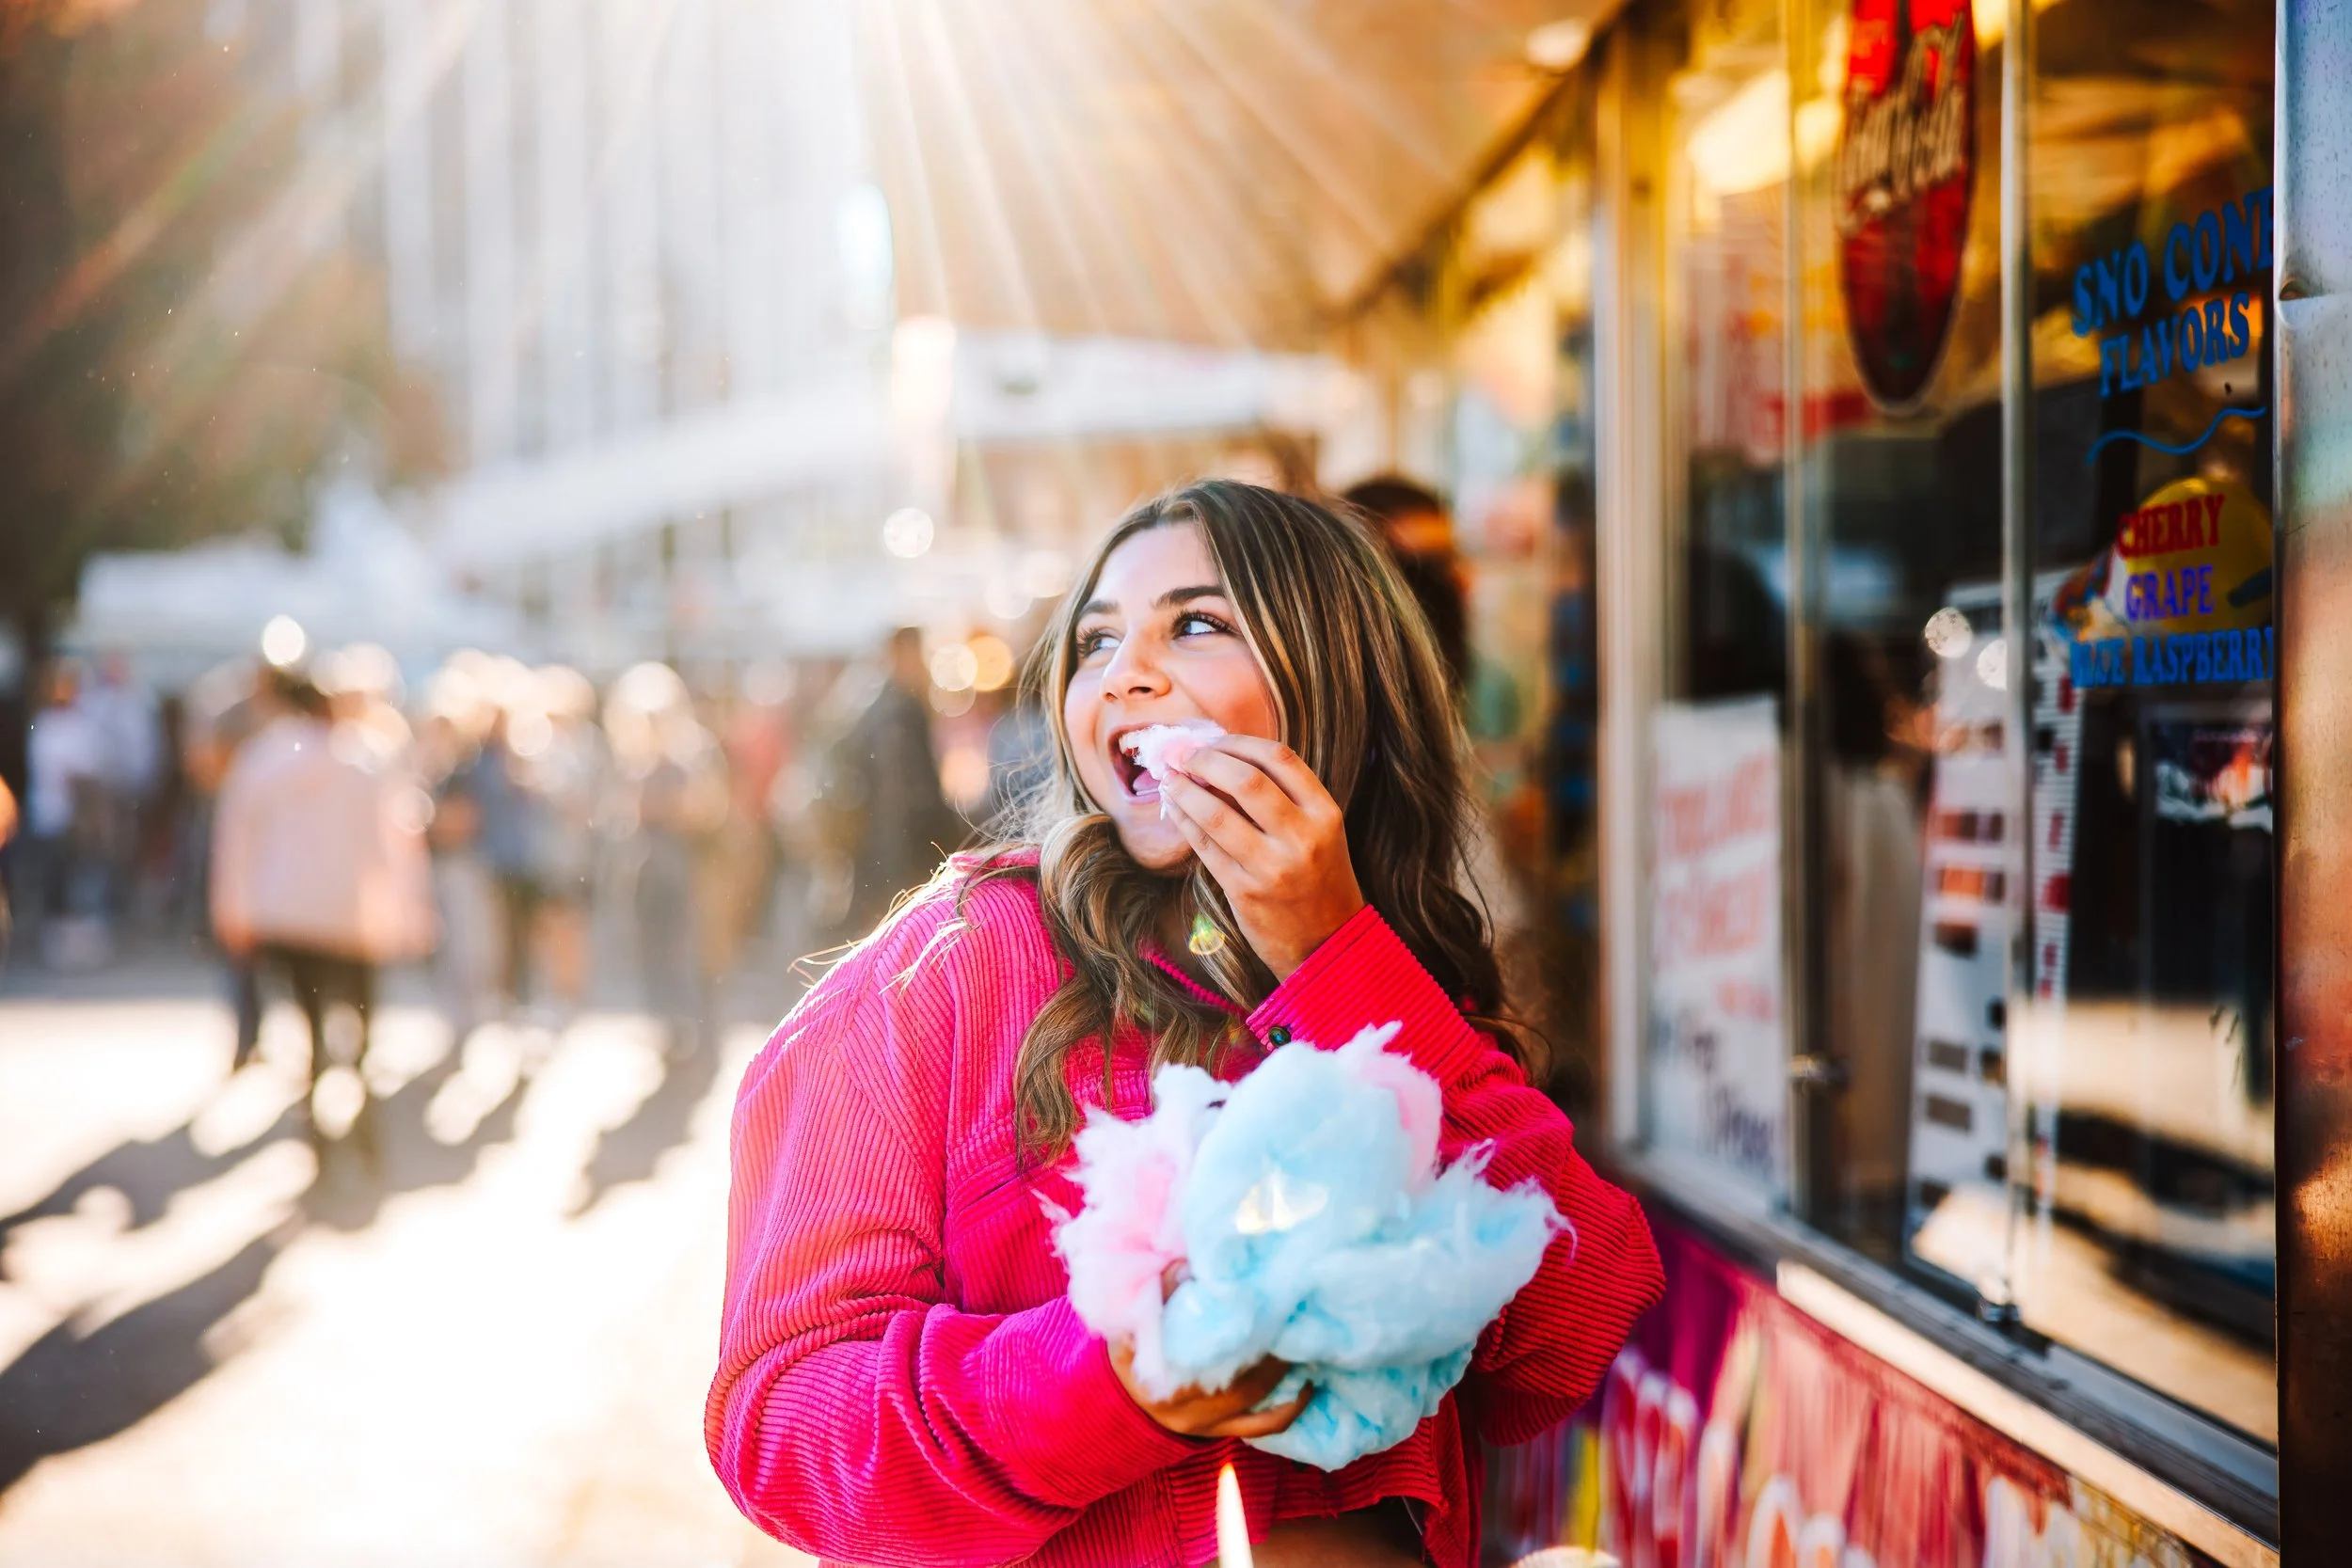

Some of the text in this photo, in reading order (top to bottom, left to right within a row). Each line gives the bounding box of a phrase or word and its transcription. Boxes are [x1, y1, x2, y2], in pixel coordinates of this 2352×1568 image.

[2072, 241, 2149, 338] SNO
[2099, 291, 2250, 400] FLAVORS
[2118, 492, 2225, 559] CHERRY
[2125, 564, 2215, 623] GRAPE
[2071, 636, 2125, 689] BLUE
